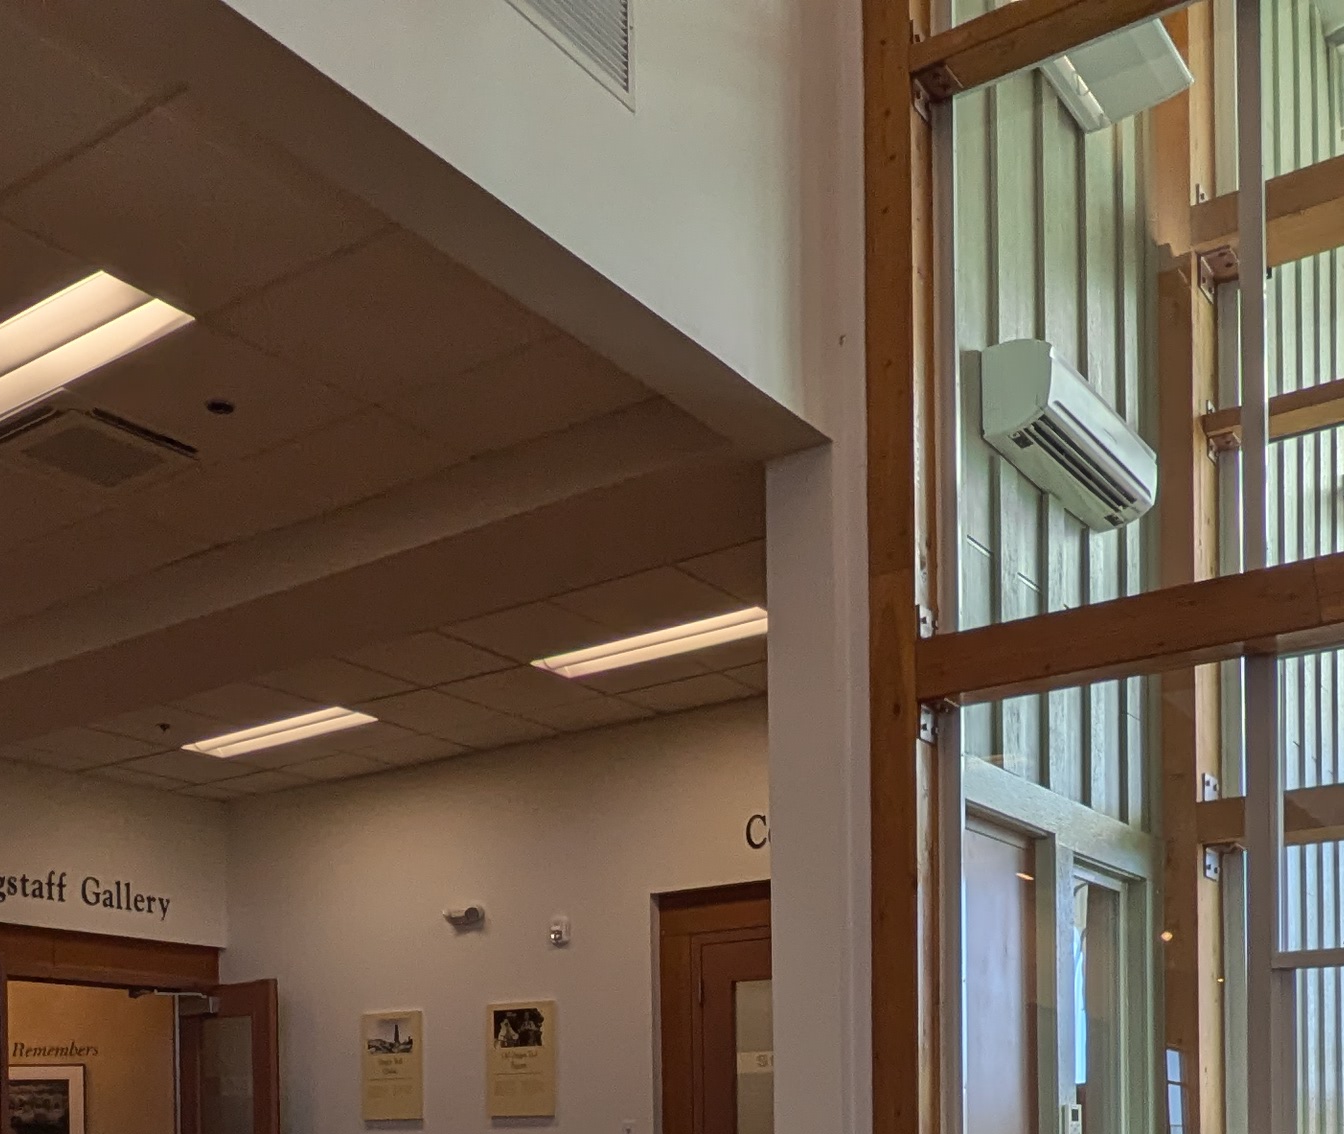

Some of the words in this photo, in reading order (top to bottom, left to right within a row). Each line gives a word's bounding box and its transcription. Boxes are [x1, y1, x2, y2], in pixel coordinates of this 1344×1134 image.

[746, 814, 771, 850] C
[81, 876, 170, 921] Gallery
[12, 1041, 99, 1057] Remembers
